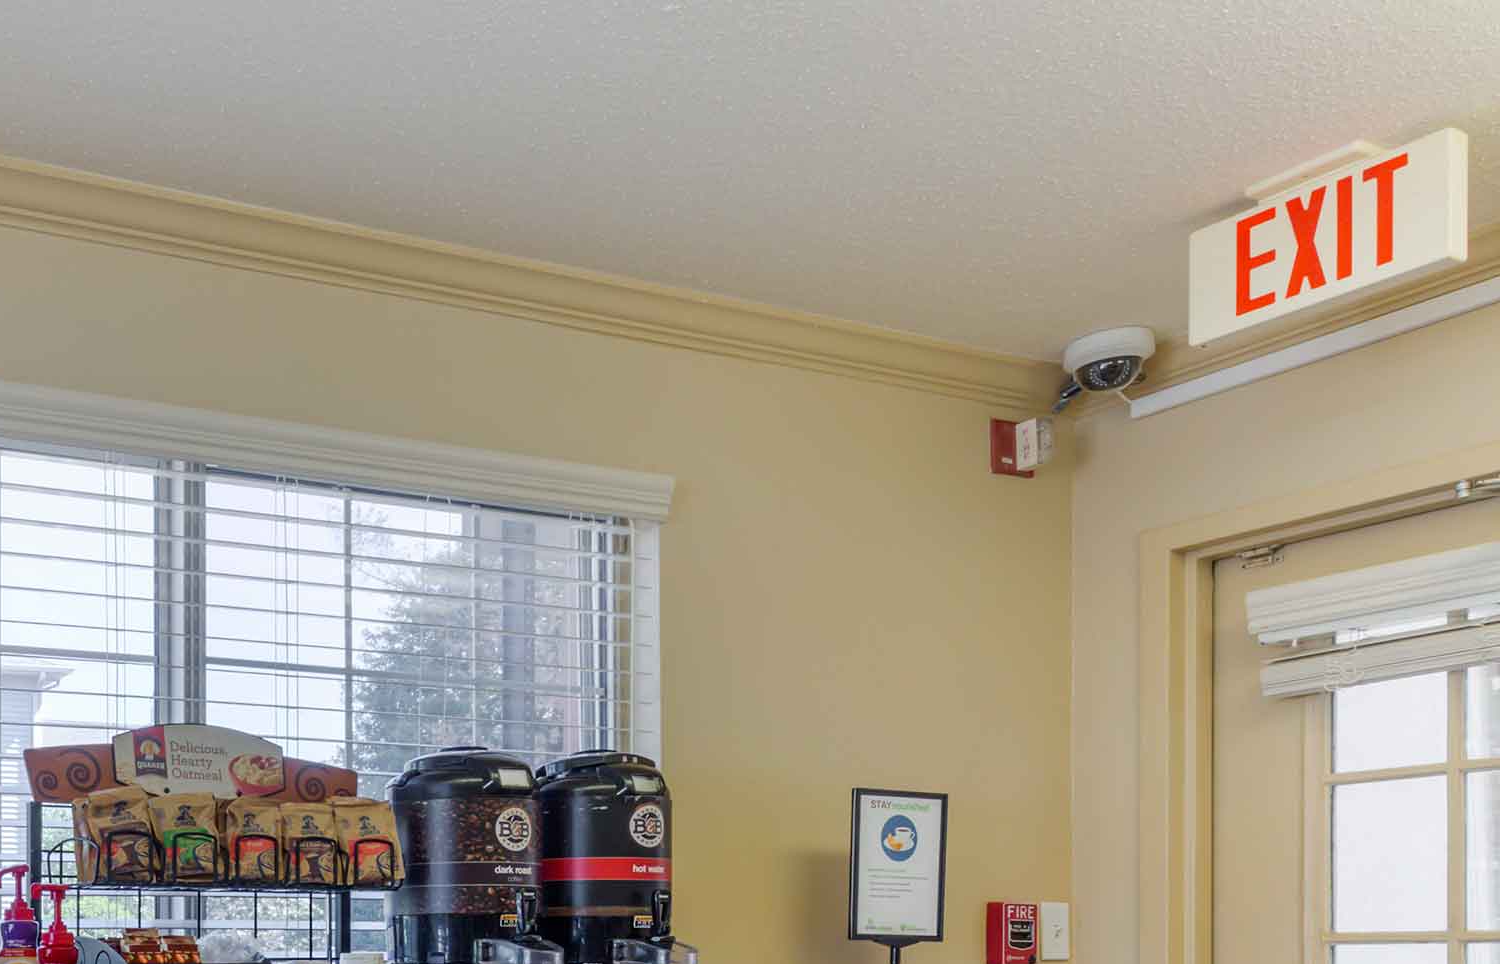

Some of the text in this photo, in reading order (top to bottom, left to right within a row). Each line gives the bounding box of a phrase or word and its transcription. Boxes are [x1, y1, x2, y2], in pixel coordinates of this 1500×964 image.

[1235, 152, 1409, 317] EXIT
[171, 754, 213, 769] Hearty
[171, 767, 223, 782] Oatmeal
[494, 864, 532, 875] dark roast
[632, 864, 646, 873] hot
[1007, 905, 1035, 919] FIRE
